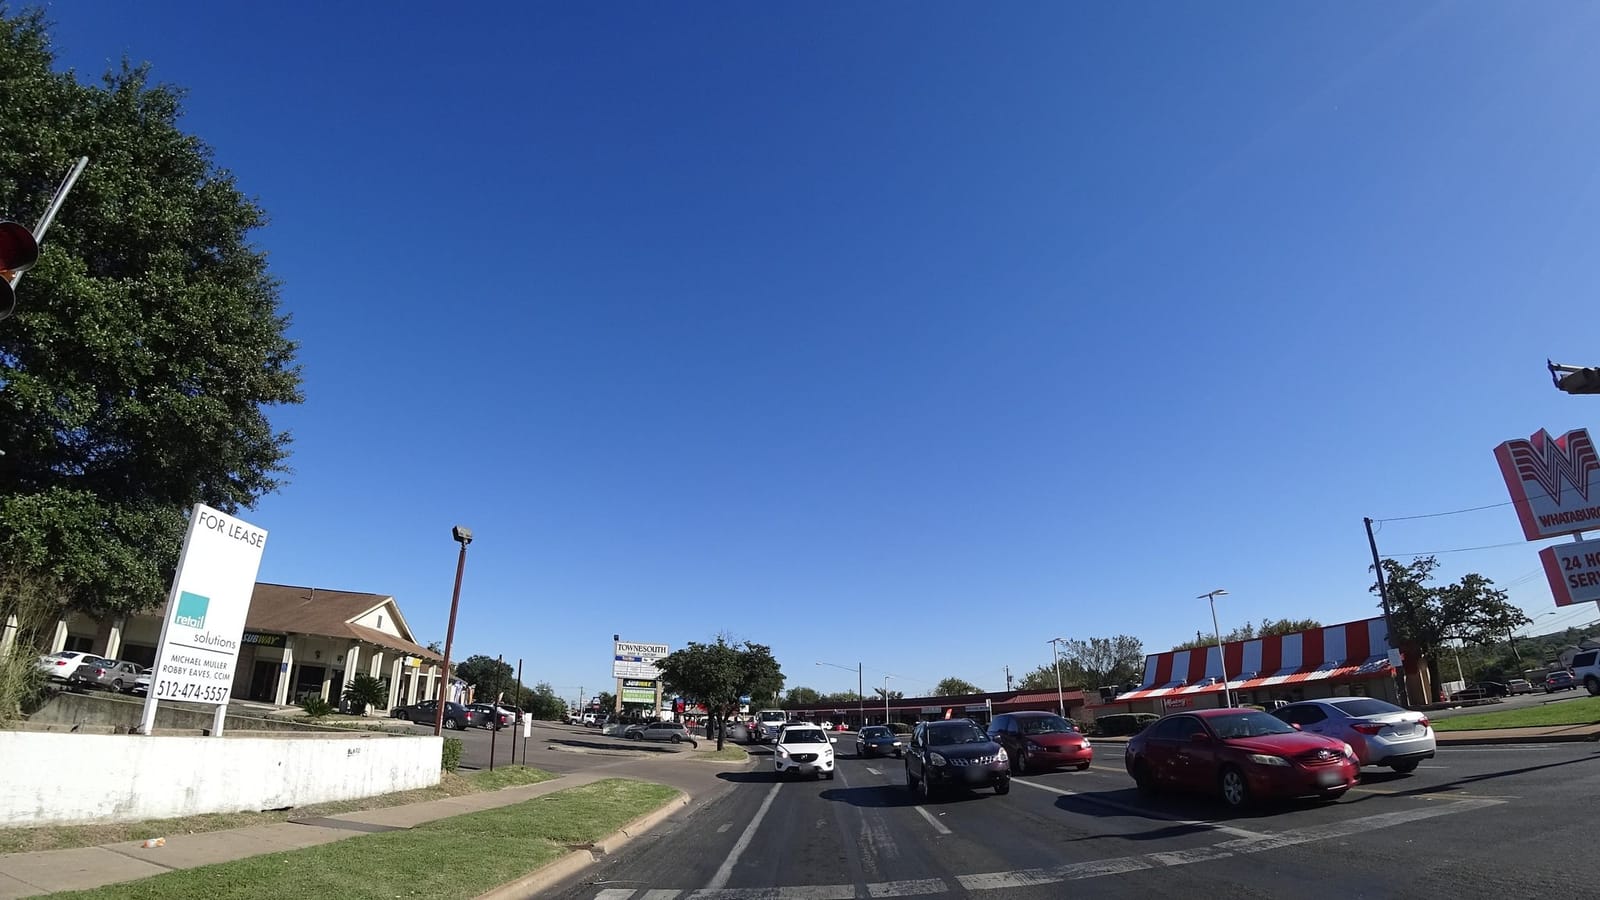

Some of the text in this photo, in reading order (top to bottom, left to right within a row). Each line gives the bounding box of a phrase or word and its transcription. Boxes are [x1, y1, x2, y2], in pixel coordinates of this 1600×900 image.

[198, 511, 264, 548] FOR LEASE
[1562, 556, 1582, 571] 24
[176, 614, 205, 629] retail
[193, 631, 237, 649] solutions
[242, 633, 280, 646] SUBWAY
[618, 644, 666, 653] TOWNESOUTH
[170, 654, 228, 670] MICHAEL MULLER
[162, 664, 187, 675] ROBBY
[214, 671, 231, 681] CCIM
[157, 680, 228, 701] 512-474-5557
